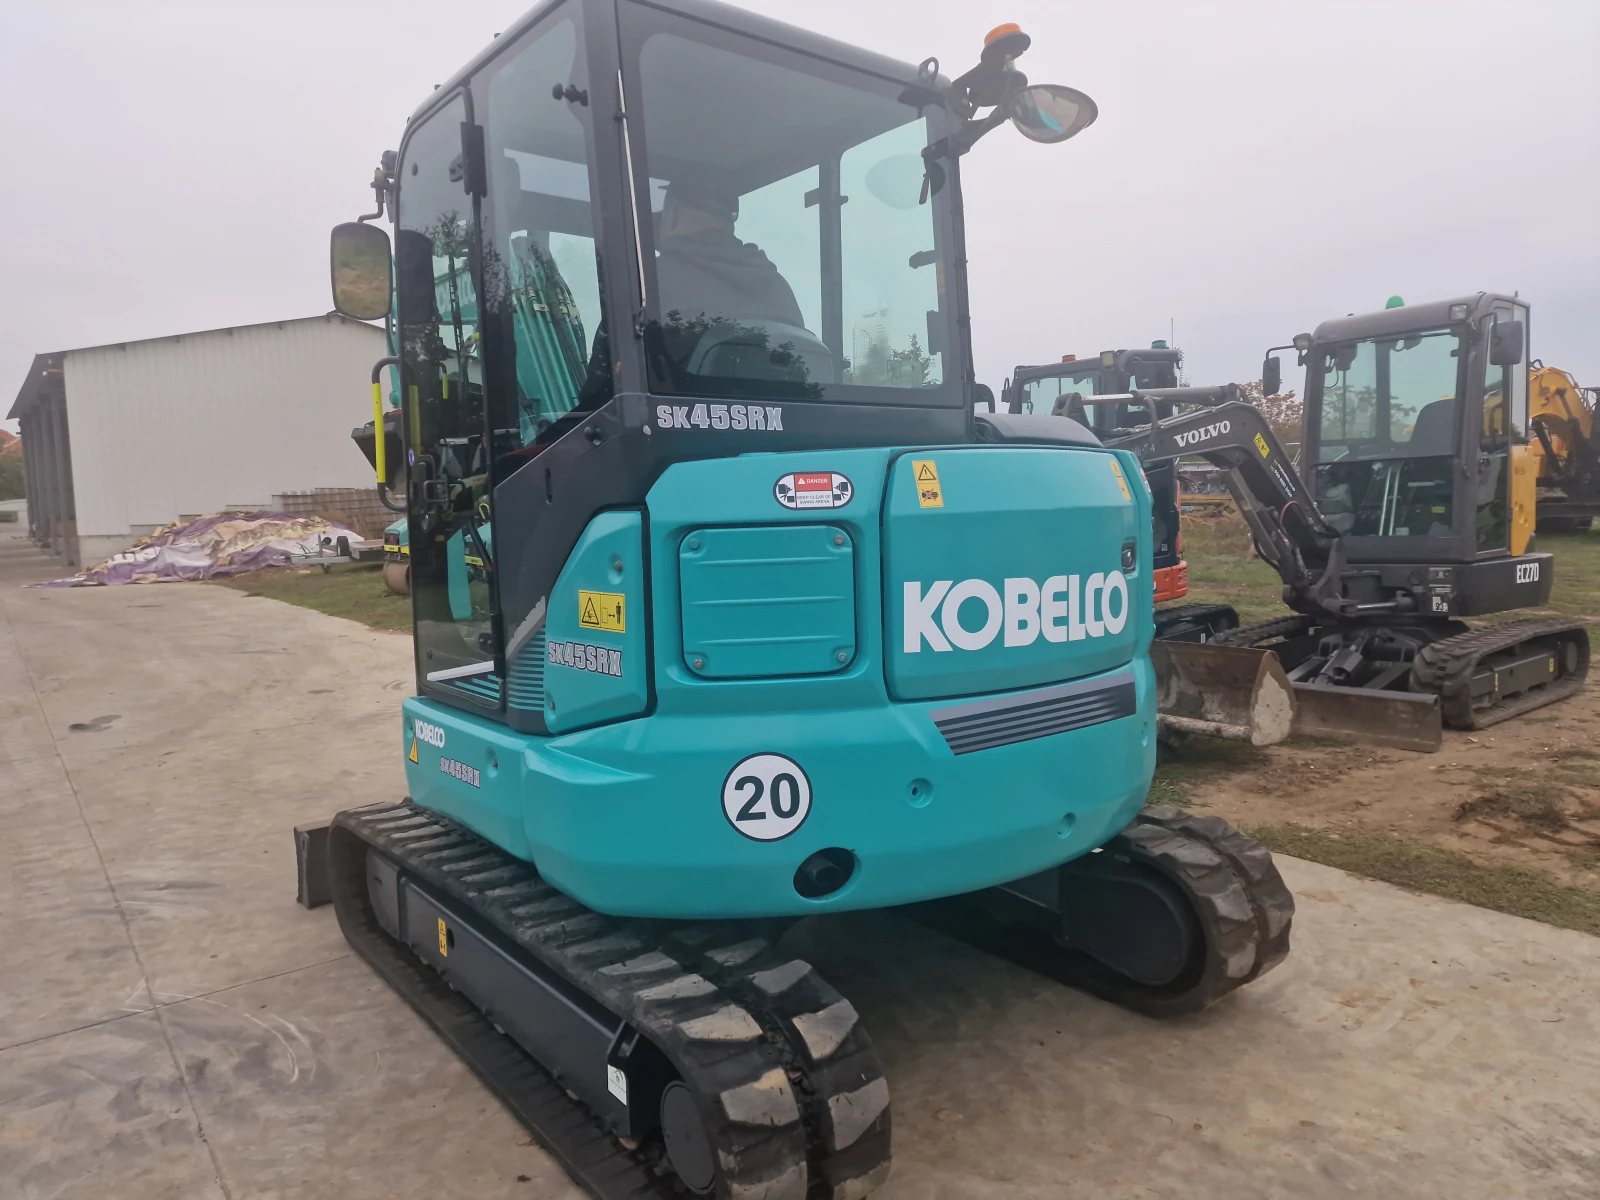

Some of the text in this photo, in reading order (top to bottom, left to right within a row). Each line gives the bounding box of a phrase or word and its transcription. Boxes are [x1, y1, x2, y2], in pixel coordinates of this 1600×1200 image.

[656, 403, 783, 432] SK45SRX
[1174, 420, 1231, 448] VOLVO
[1516, 562, 1540, 584] EC27D
[903, 569, 1129, 654] KOBELCO
[547, 640, 623, 678] SK45SRX
[414, 718, 446, 749] KOBELCO
[440, 757, 481, 789] SK45SRX
[734, 772, 800, 822] 20
